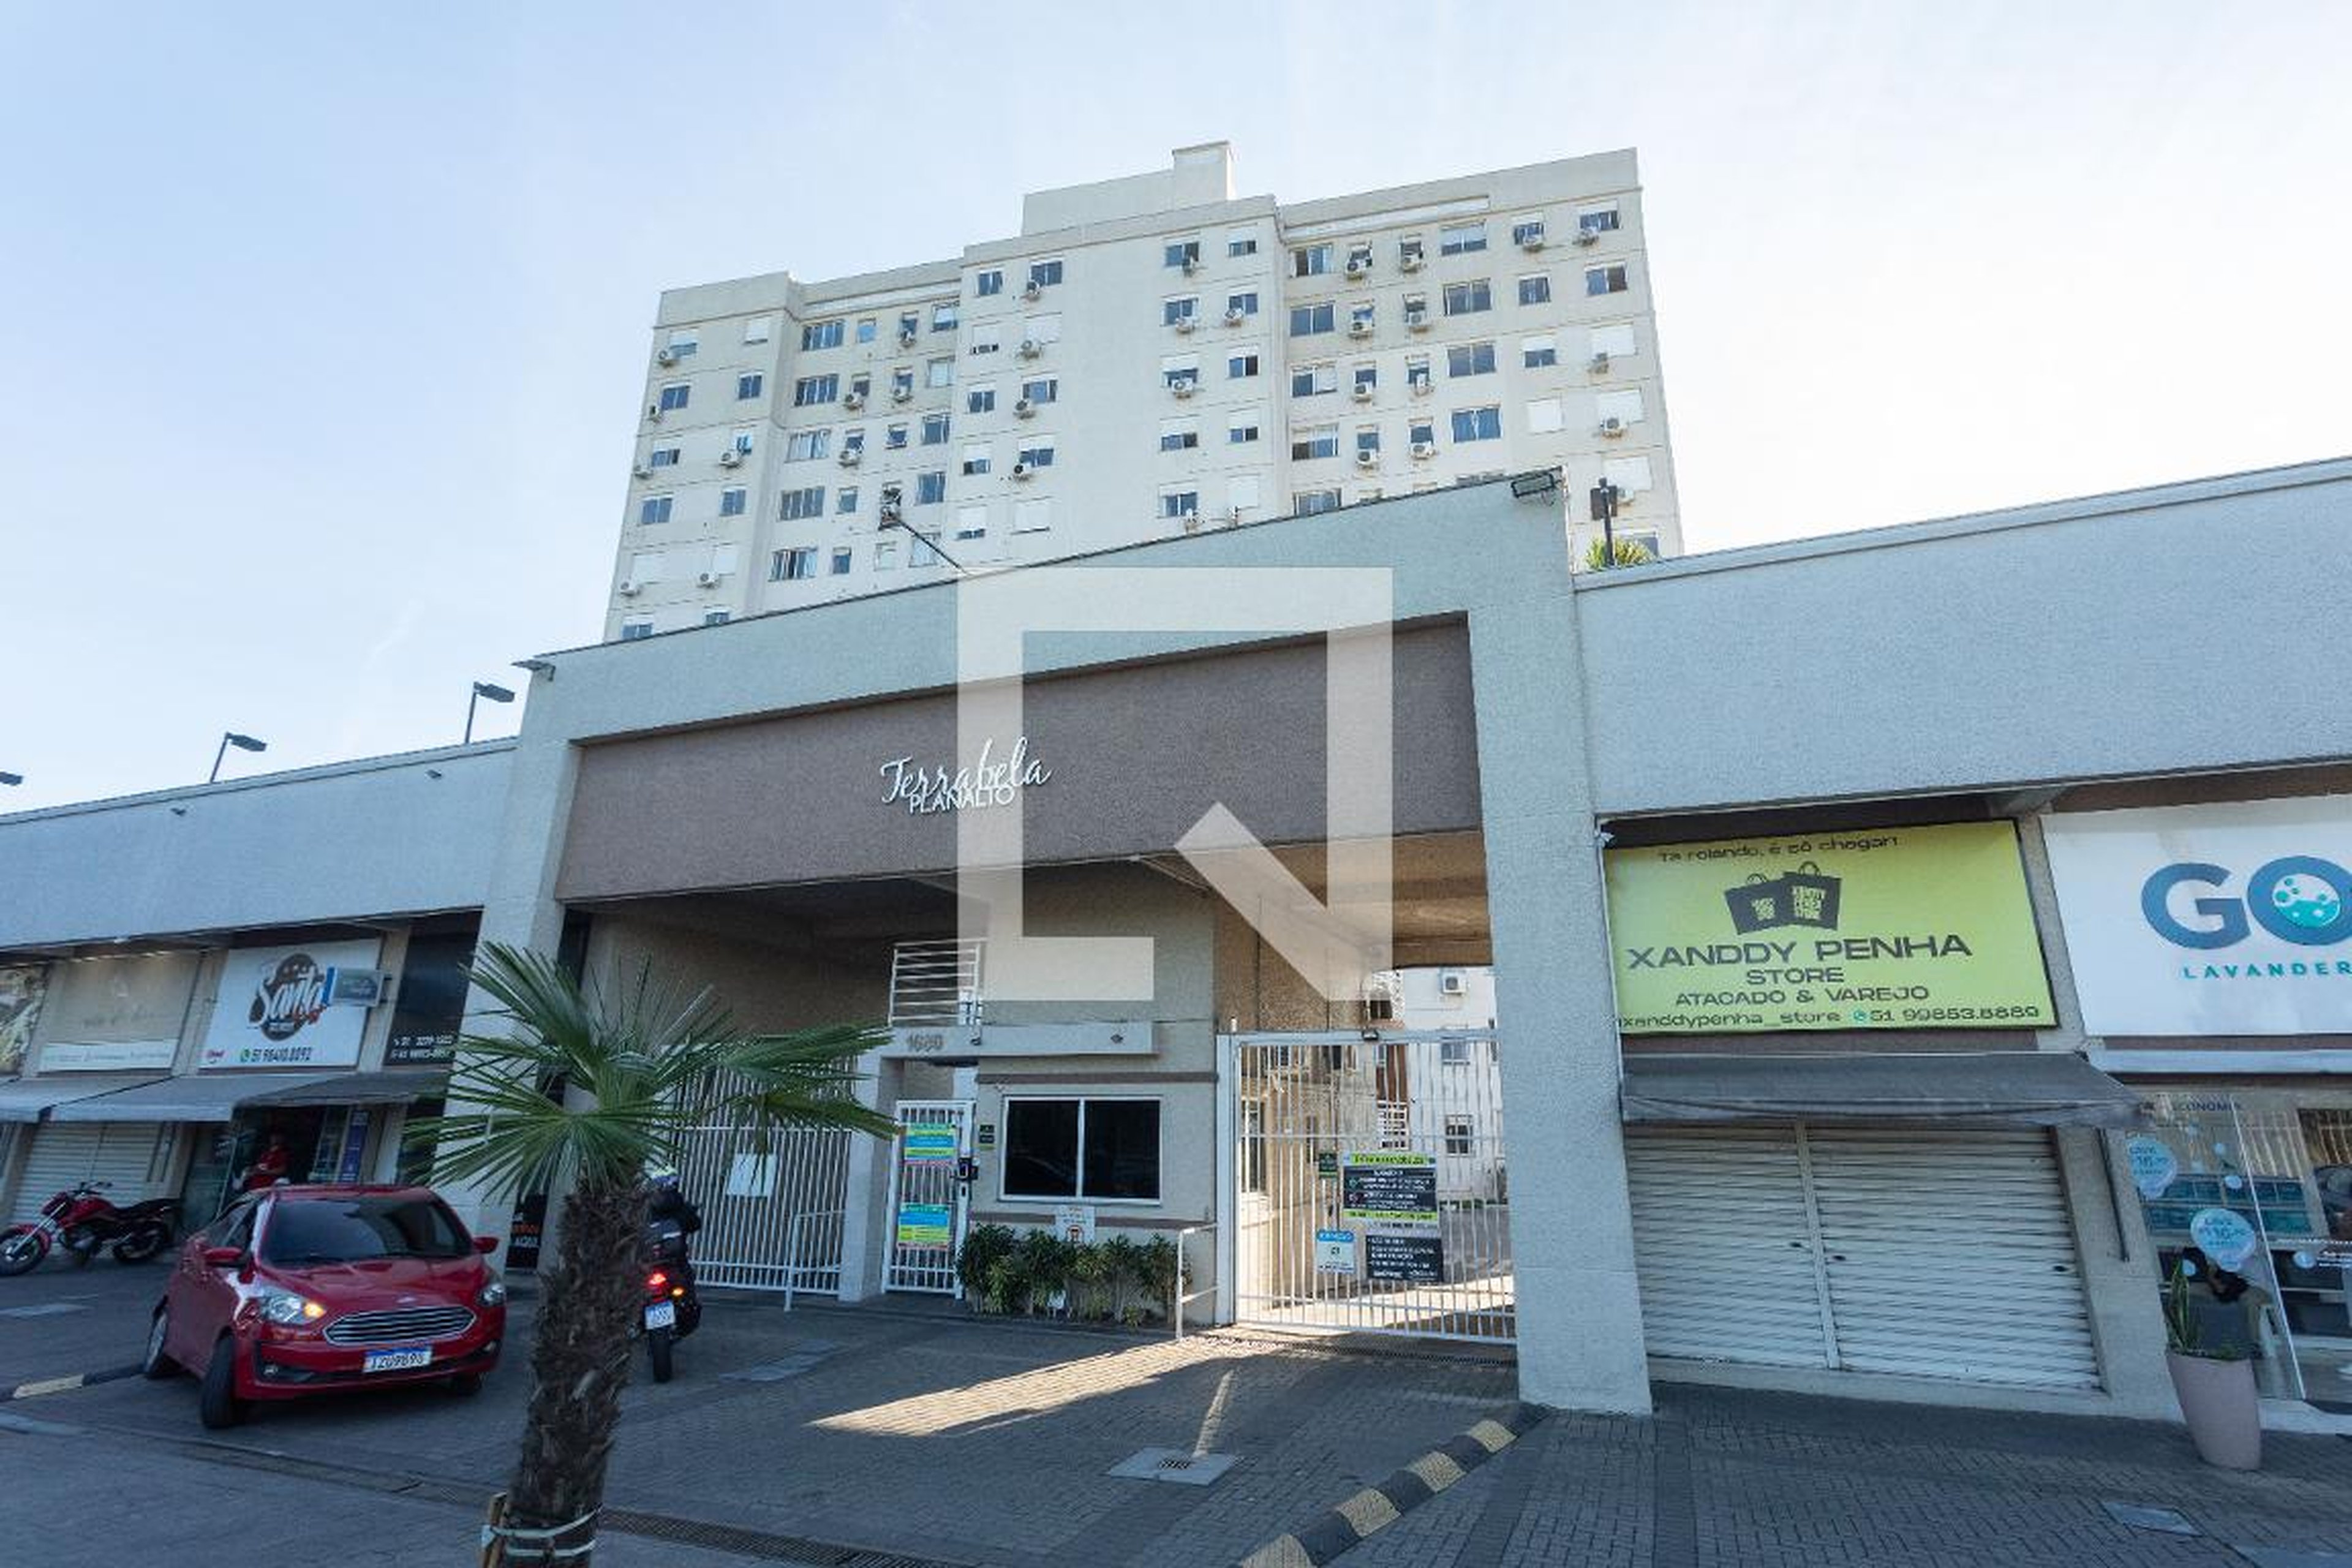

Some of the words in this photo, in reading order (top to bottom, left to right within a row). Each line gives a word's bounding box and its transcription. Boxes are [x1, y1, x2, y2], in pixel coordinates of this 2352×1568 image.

[880, 736, 1052, 803] Terrabela
[910, 787, 1015, 813] PLANALTO
[1626, 941, 1797, 969] XANDDY
[1815, 935, 1973, 961] PENHA
[1747, 967, 1844, 985] STORE
[1676, 990, 1785, 1006] ATACADO
[1796, 988, 1813, 1003] &
[1825, 986, 1929, 1001] VAREJO
[1870, 1009, 1894, 1021] 51
